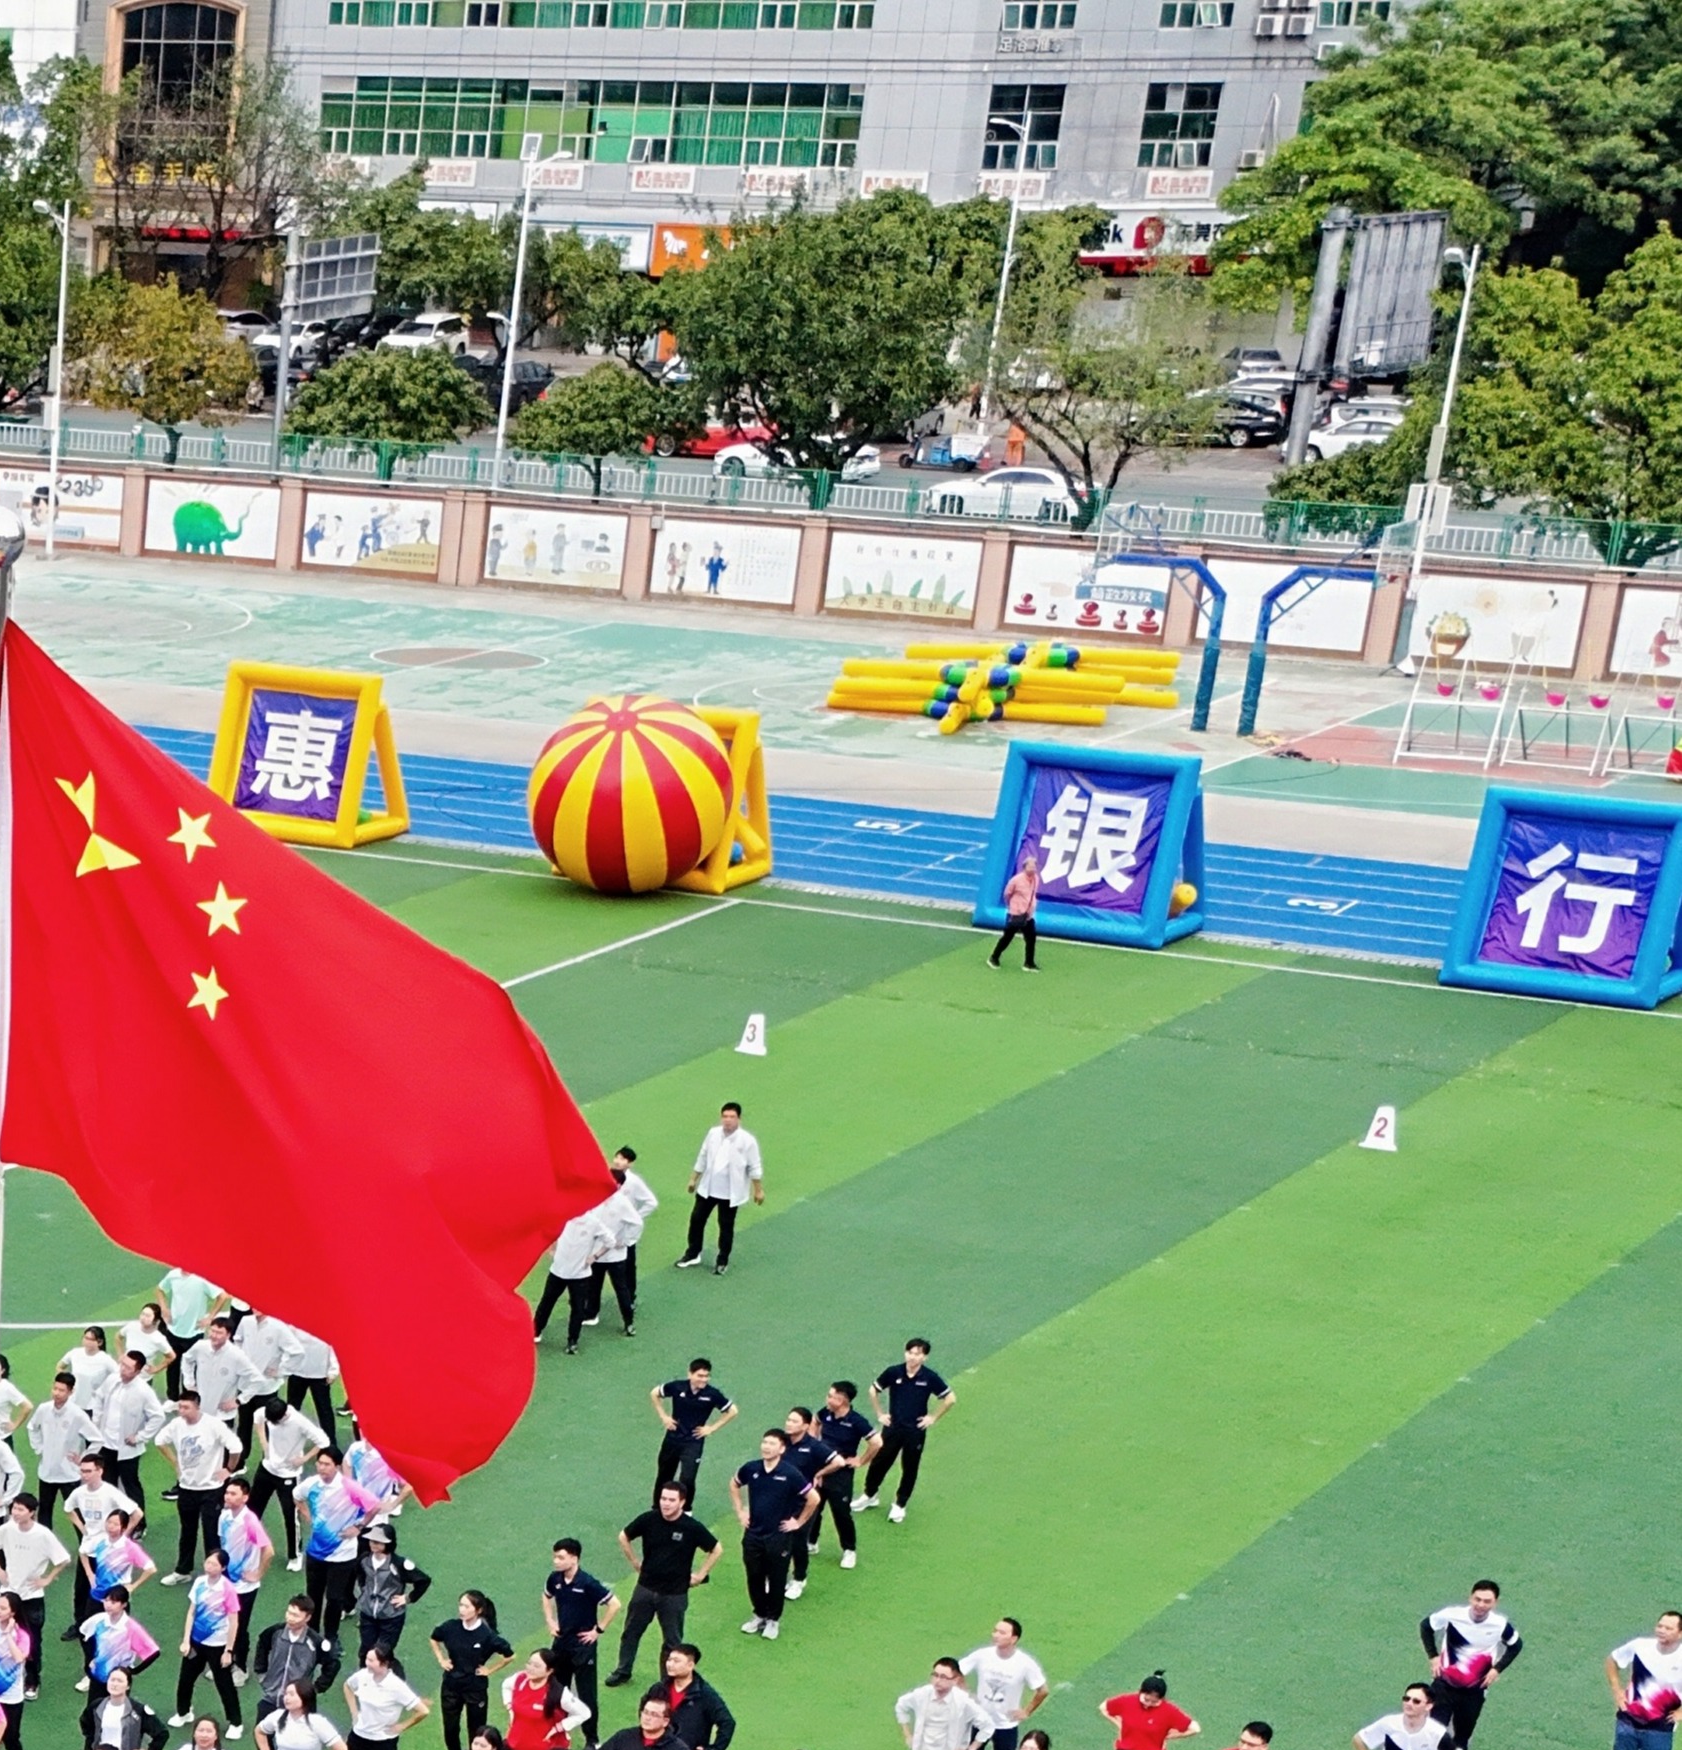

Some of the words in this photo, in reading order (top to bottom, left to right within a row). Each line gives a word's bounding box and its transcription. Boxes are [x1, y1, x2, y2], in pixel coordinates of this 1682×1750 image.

[250, 710, 343, 802] 惠
[1039, 784, 1149, 893] 银
[1515, 842, 1639, 954] 行
[746, 1023, 757, 1043] 3
[1374, 1117, 1388, 1138] 2
